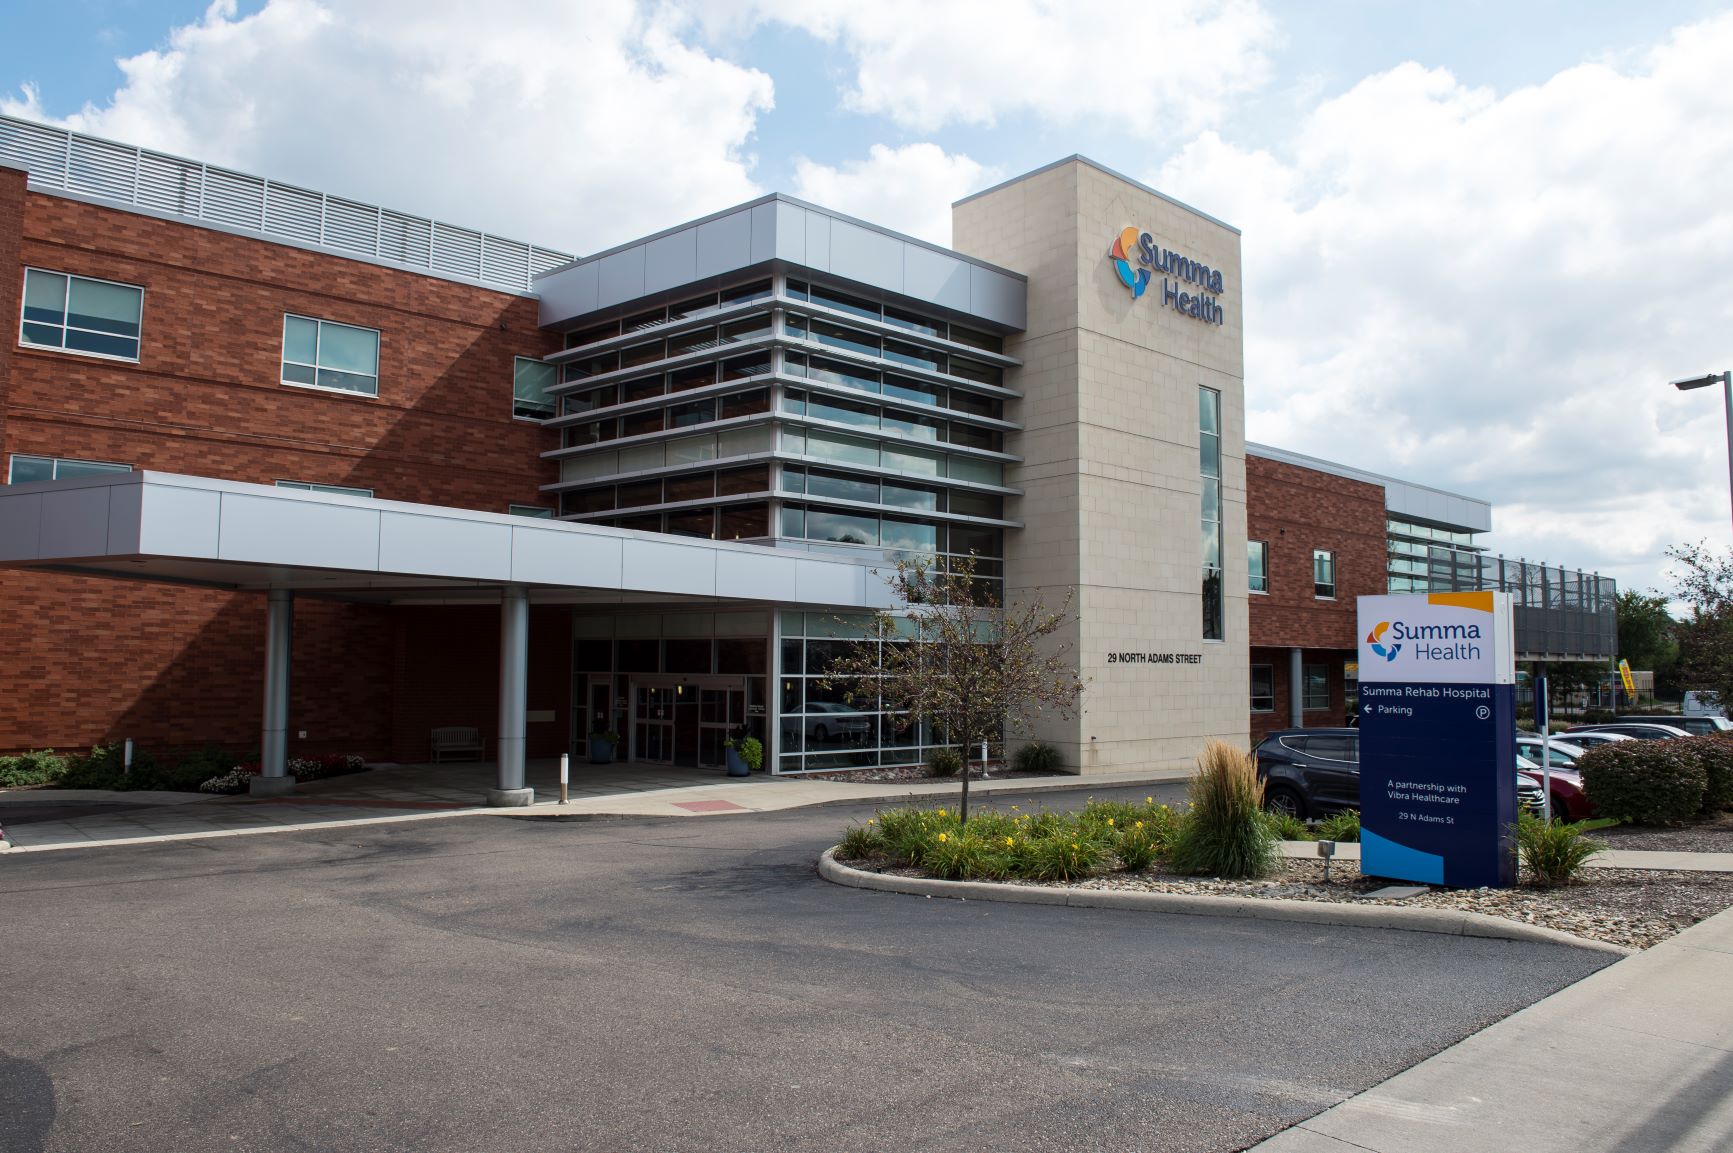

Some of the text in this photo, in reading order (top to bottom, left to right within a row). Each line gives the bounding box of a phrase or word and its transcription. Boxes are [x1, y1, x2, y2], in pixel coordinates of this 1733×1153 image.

[1138, 232, 1224, 294] Summa
[1161, 277, 1224, 326] Health
[1392, 621, 1481, 640] Summa
[1415, 642, 1480, 660] Health
[1107, 653, 1202, 664] 29 NORTH ADAMS STREET
[1362, 686, 1491, 700] Summa Rehab Hospital
[1378, 705, 1413, 716] Parking
[1387, 780, 1467, 793] A partnership with
[1388, 790, 1460, 804] Vibra Healthcare
[1398, 812, 1454, 825] 29 N Adams St
